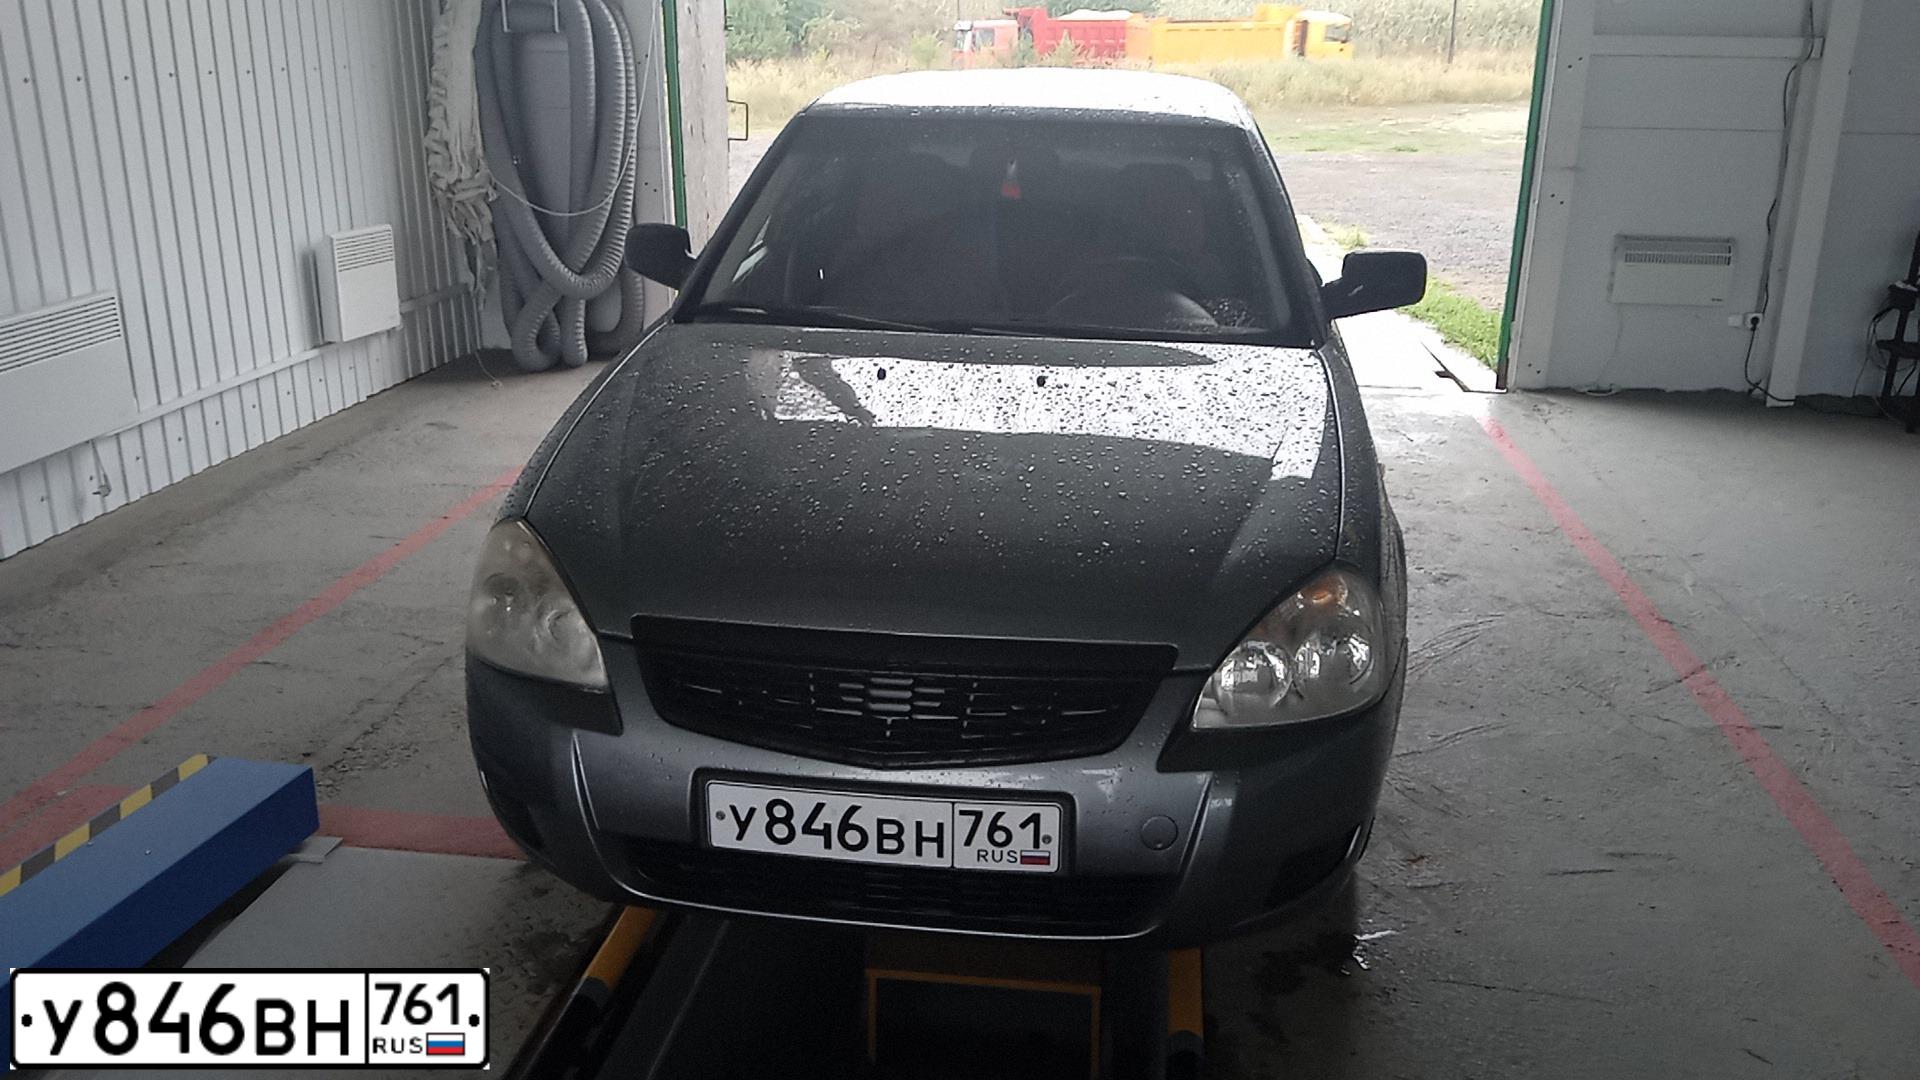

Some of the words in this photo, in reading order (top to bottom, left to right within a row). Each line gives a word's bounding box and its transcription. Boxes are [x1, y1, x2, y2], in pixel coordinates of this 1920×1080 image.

[729, 798, 944, 858] У846ВН
[958, 810, 1041, 849] 761
[977, 849, 1018, 864] RUS
